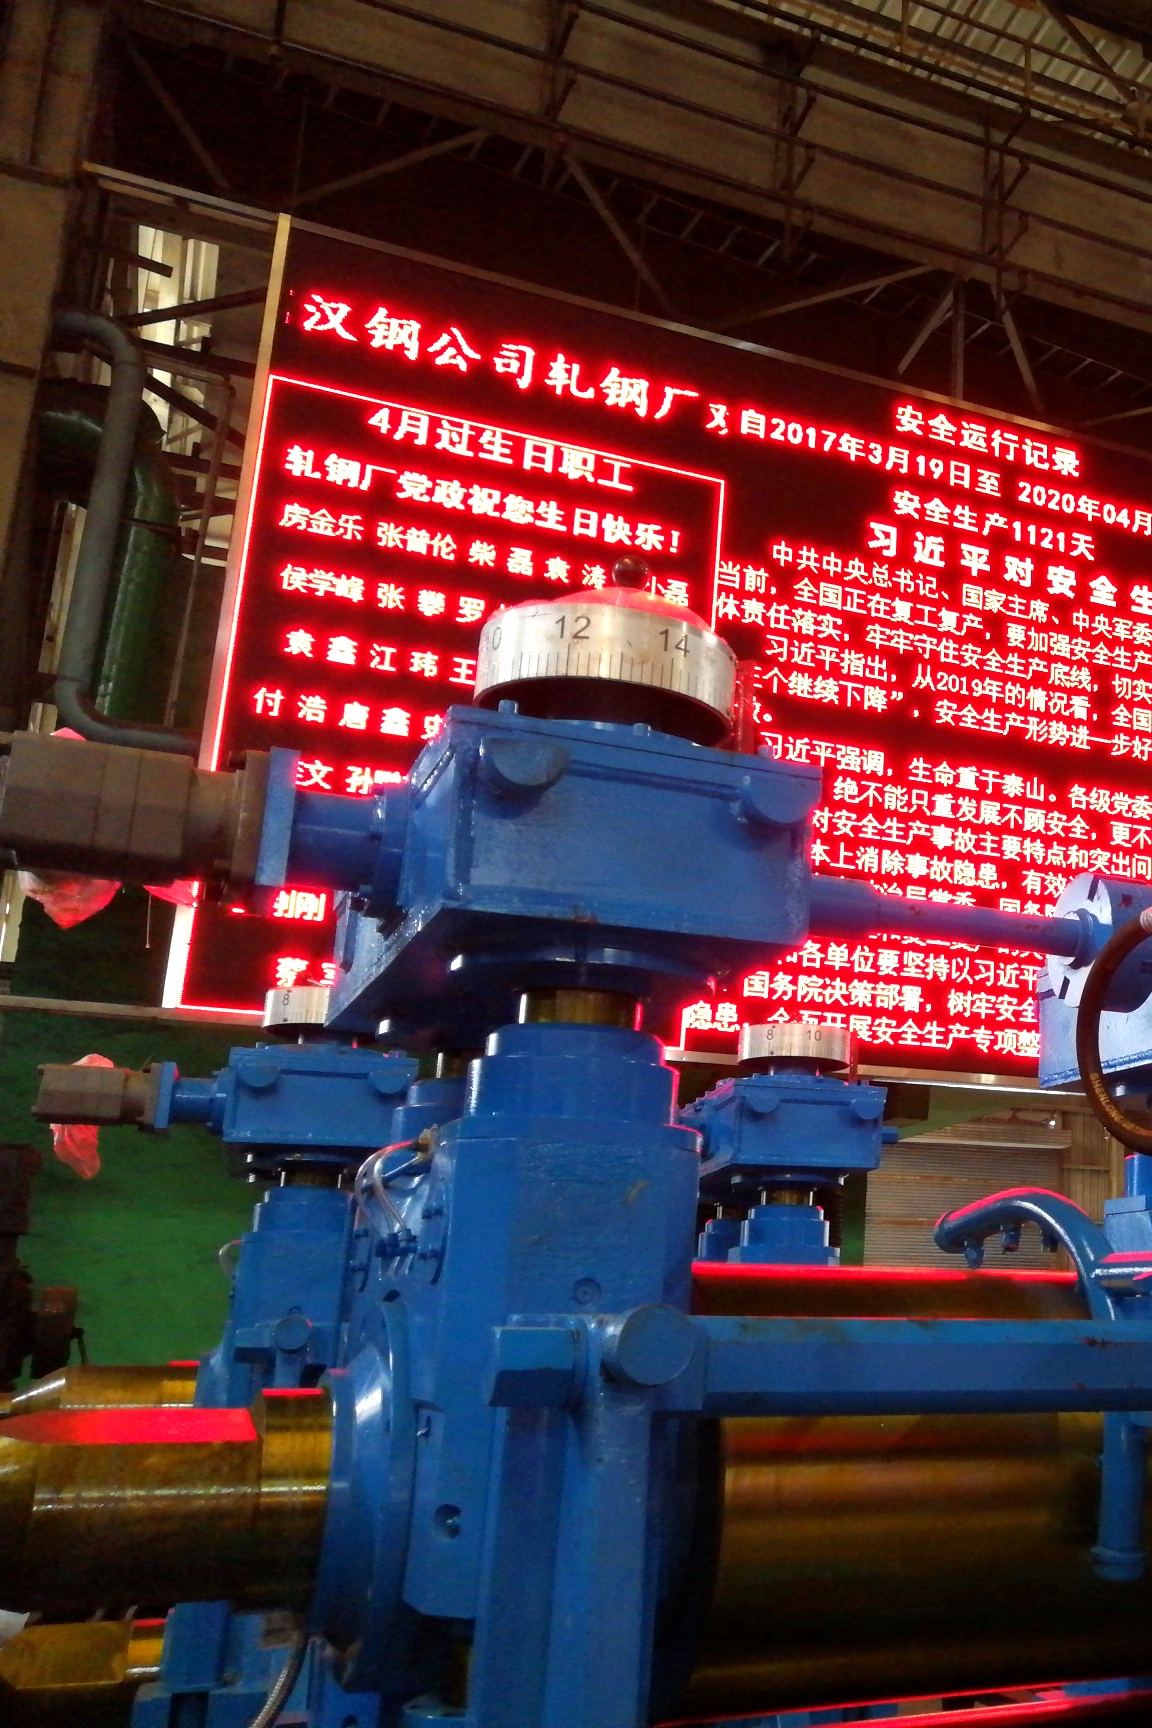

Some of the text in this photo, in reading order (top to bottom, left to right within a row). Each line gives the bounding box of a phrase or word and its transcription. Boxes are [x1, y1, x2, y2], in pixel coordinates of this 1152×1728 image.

[367, 407, 634, 492] 4月过生日职工
[740, 408, 1001, 497] 自2017年3月19日至
[895, 404, 1080, 478] 安全运行记录
[284, 444, 680, 554] 轧钢厂党政祝您生日快乐！
[893, 490, 1095, 561] 安全生产1121天
[554, 614, 592, 641] 12
[658, 627, 691, 658] 14
[281, 992, 290, 1007] 8
[765, 1028, 823, 1042] 8 10
